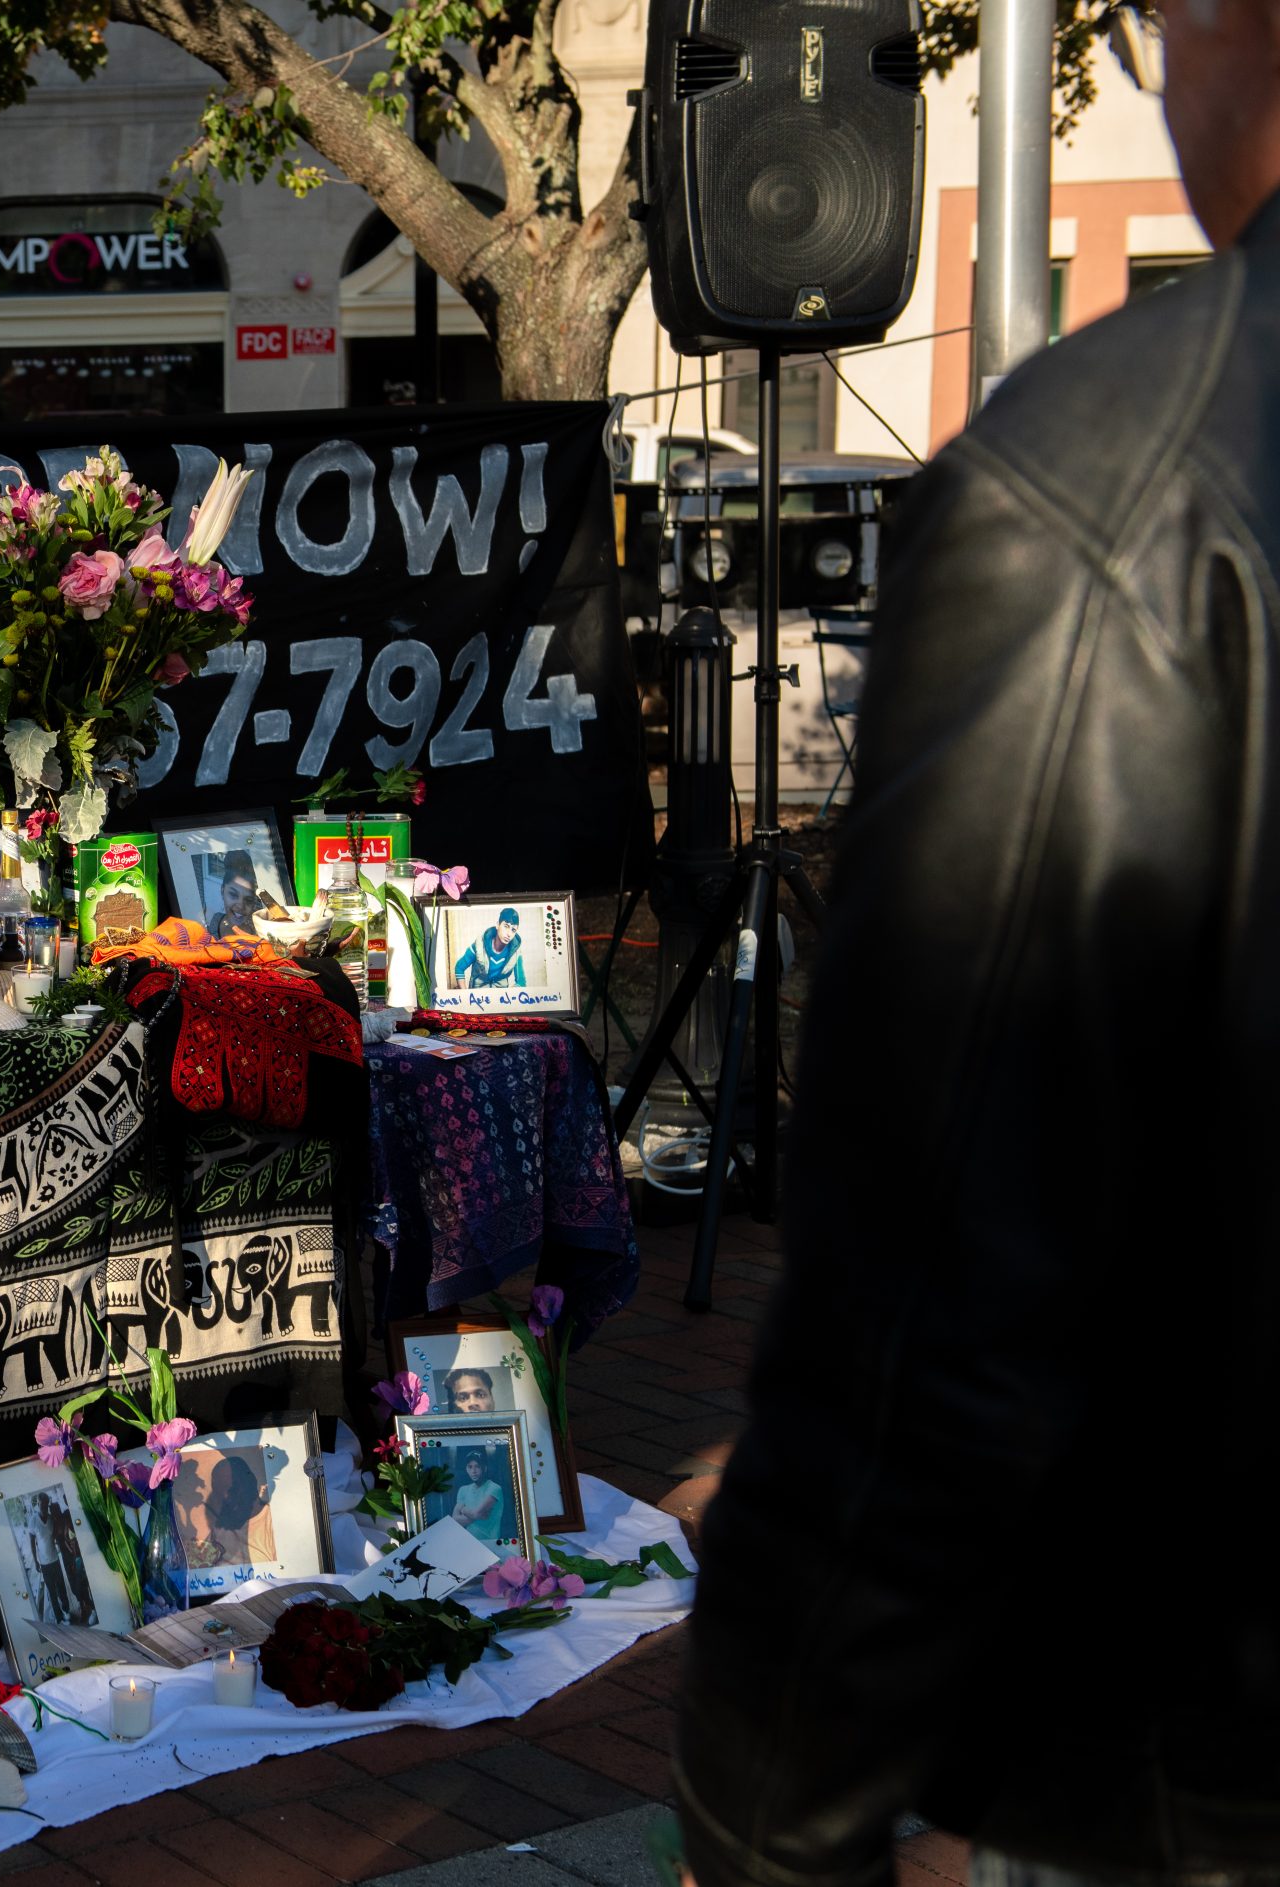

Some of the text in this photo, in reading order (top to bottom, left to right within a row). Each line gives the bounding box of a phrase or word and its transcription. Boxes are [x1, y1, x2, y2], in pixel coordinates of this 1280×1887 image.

[241, 331, 283, 353] FDC
[165, 438, 549, 577] NOW!
[323, 839, 388, 863] نابس
[28, 1651, 72, 1677] Dennis
